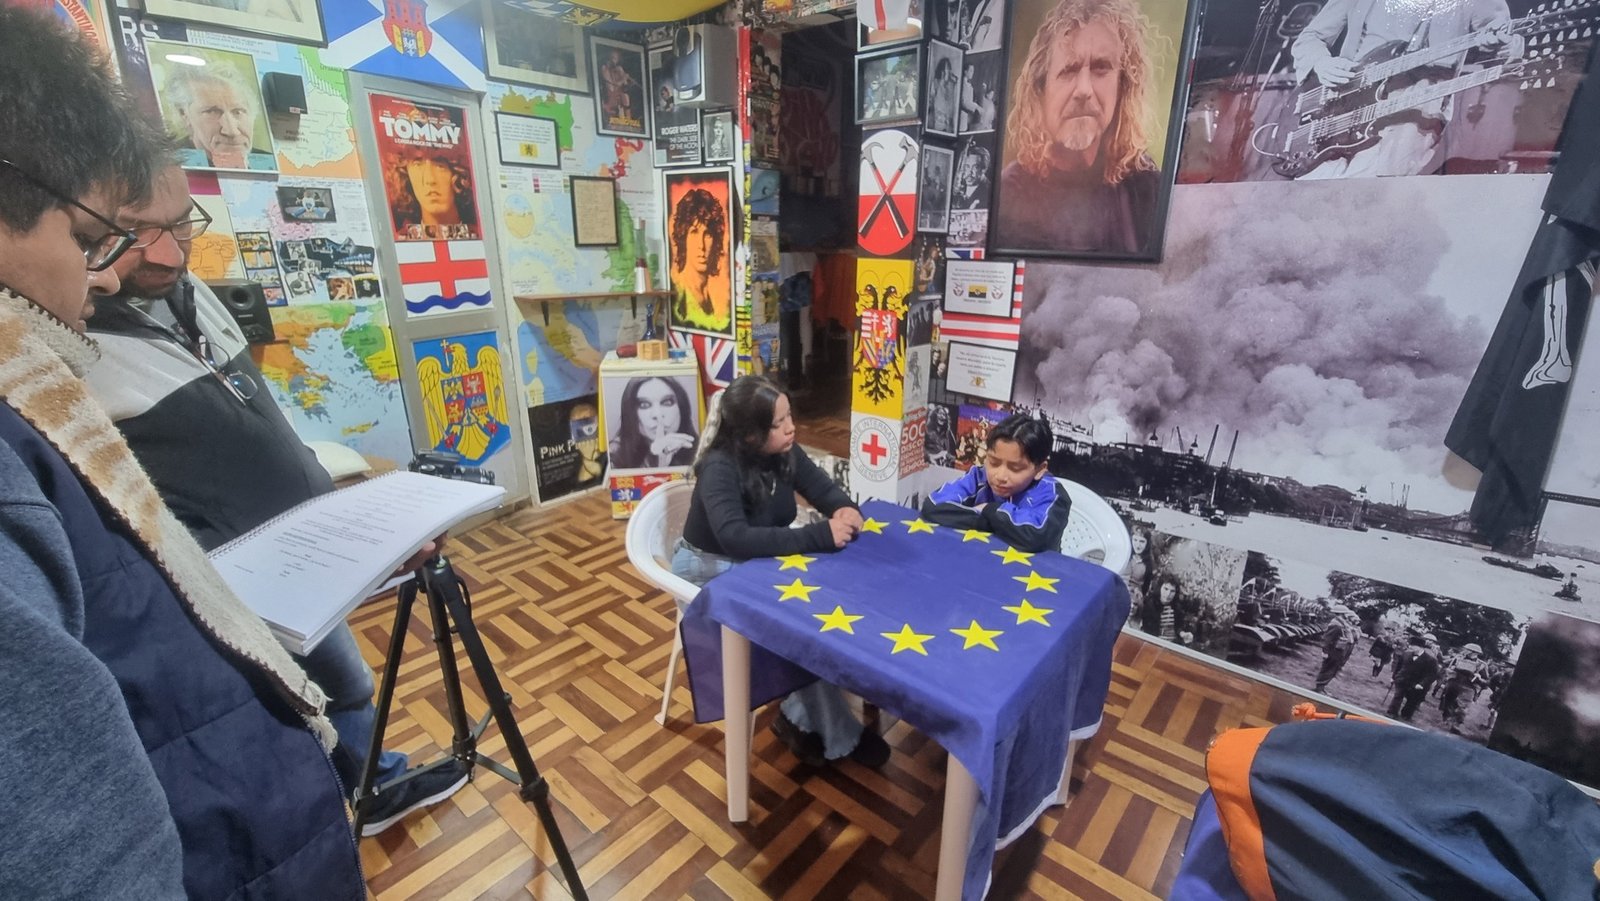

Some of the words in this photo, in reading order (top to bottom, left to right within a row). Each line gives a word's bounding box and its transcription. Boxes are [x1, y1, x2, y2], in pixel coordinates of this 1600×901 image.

[379, 116, 461, 145] TOMMY
[661, 126, 679, 135] ROGER
[680, 124, 698, 133] WATERS
[540, 443, 566, 459] PINK
